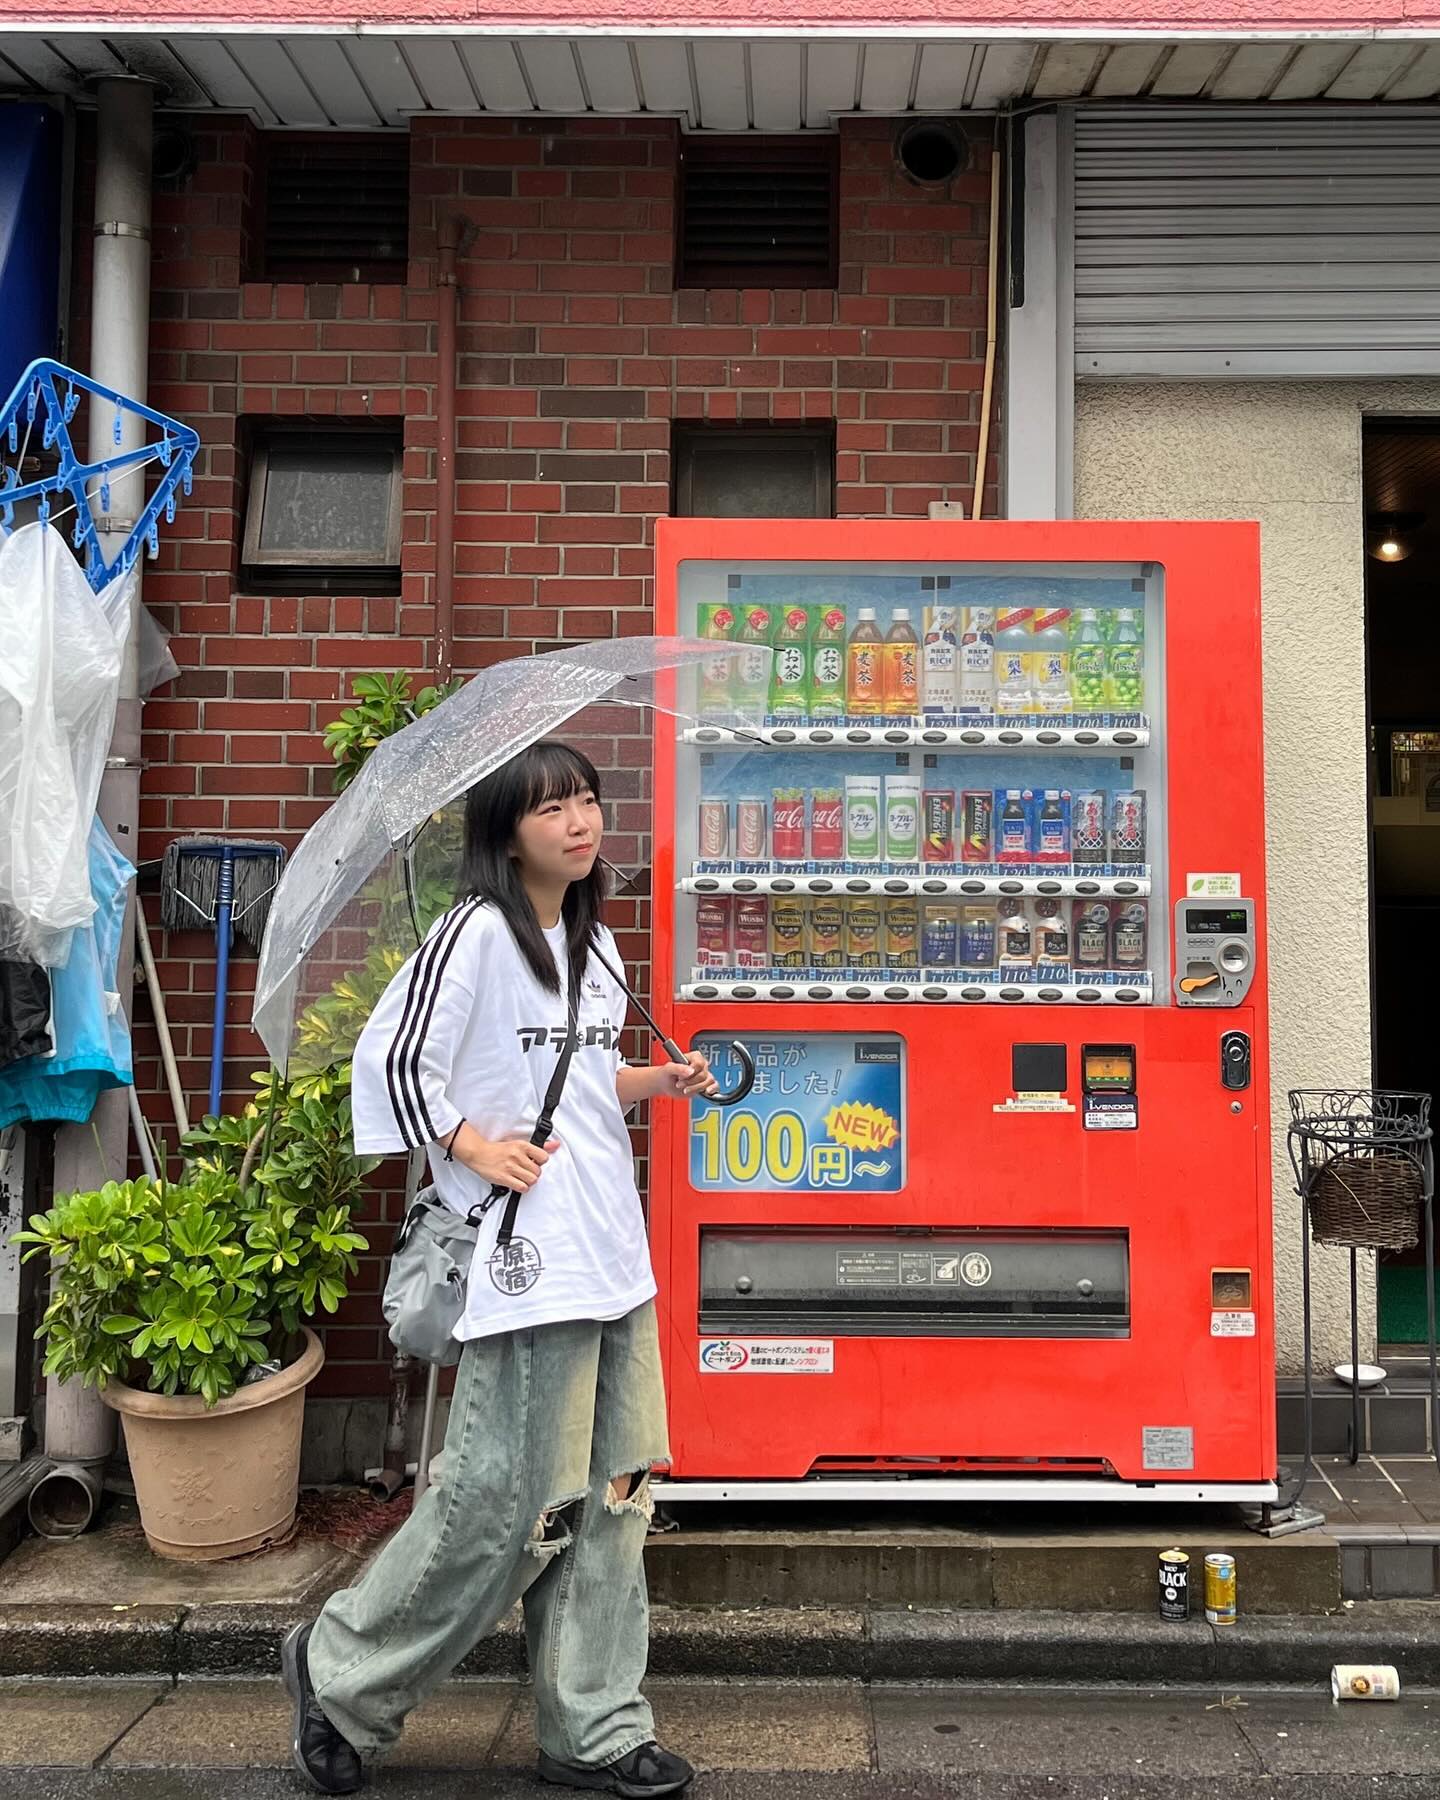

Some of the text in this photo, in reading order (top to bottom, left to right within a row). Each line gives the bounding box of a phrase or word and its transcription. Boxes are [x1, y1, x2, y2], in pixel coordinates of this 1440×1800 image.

[785, 649, 800, 680] お茶
[823, 649, 838, 680] お茶
[857, 651, 873, 685] 麦茶
[902, 651, 917, 685] 麦茶
[929, 657, 952, 665] RICH
[966, 658, 989, 666] RICH
[933, 798, 942, 834] ENERGY
[974, 798, 983, 834] ENERGY
[1004, 970, 1028, 982] 110
[1041, 967, 1064, 979] 110
[516, 1018, 619, 1053] アデダ
[724, 1068, 842, 1096] りました!
[833, 1111, 890, 1143] NEW
[503, 1241, 527, 1291] 原宿
